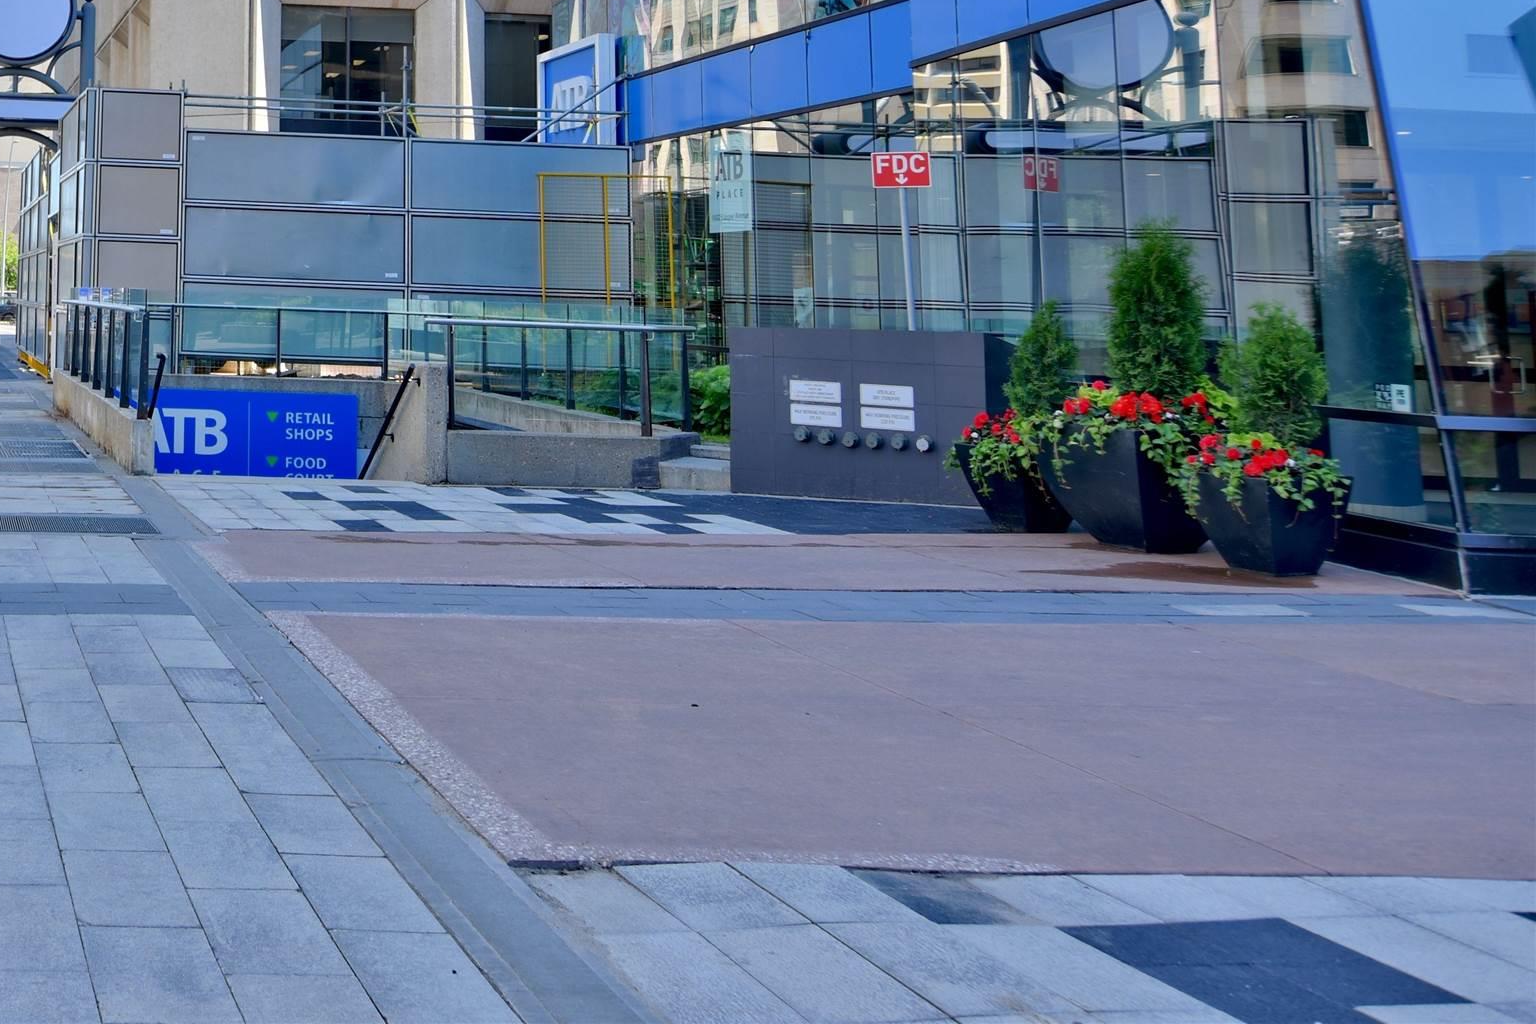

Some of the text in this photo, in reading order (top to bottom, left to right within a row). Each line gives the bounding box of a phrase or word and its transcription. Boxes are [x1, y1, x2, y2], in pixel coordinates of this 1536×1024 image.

[715, 149, 744, 182] ATB
[875, 154, 926, 174] FDC
[715, 188, 744, 200] PLACE
[285, 412, 335, 425] RETAIL
[285, 428, 334, 441] SHOPS
[285, 457, 327, 470] FOOD
